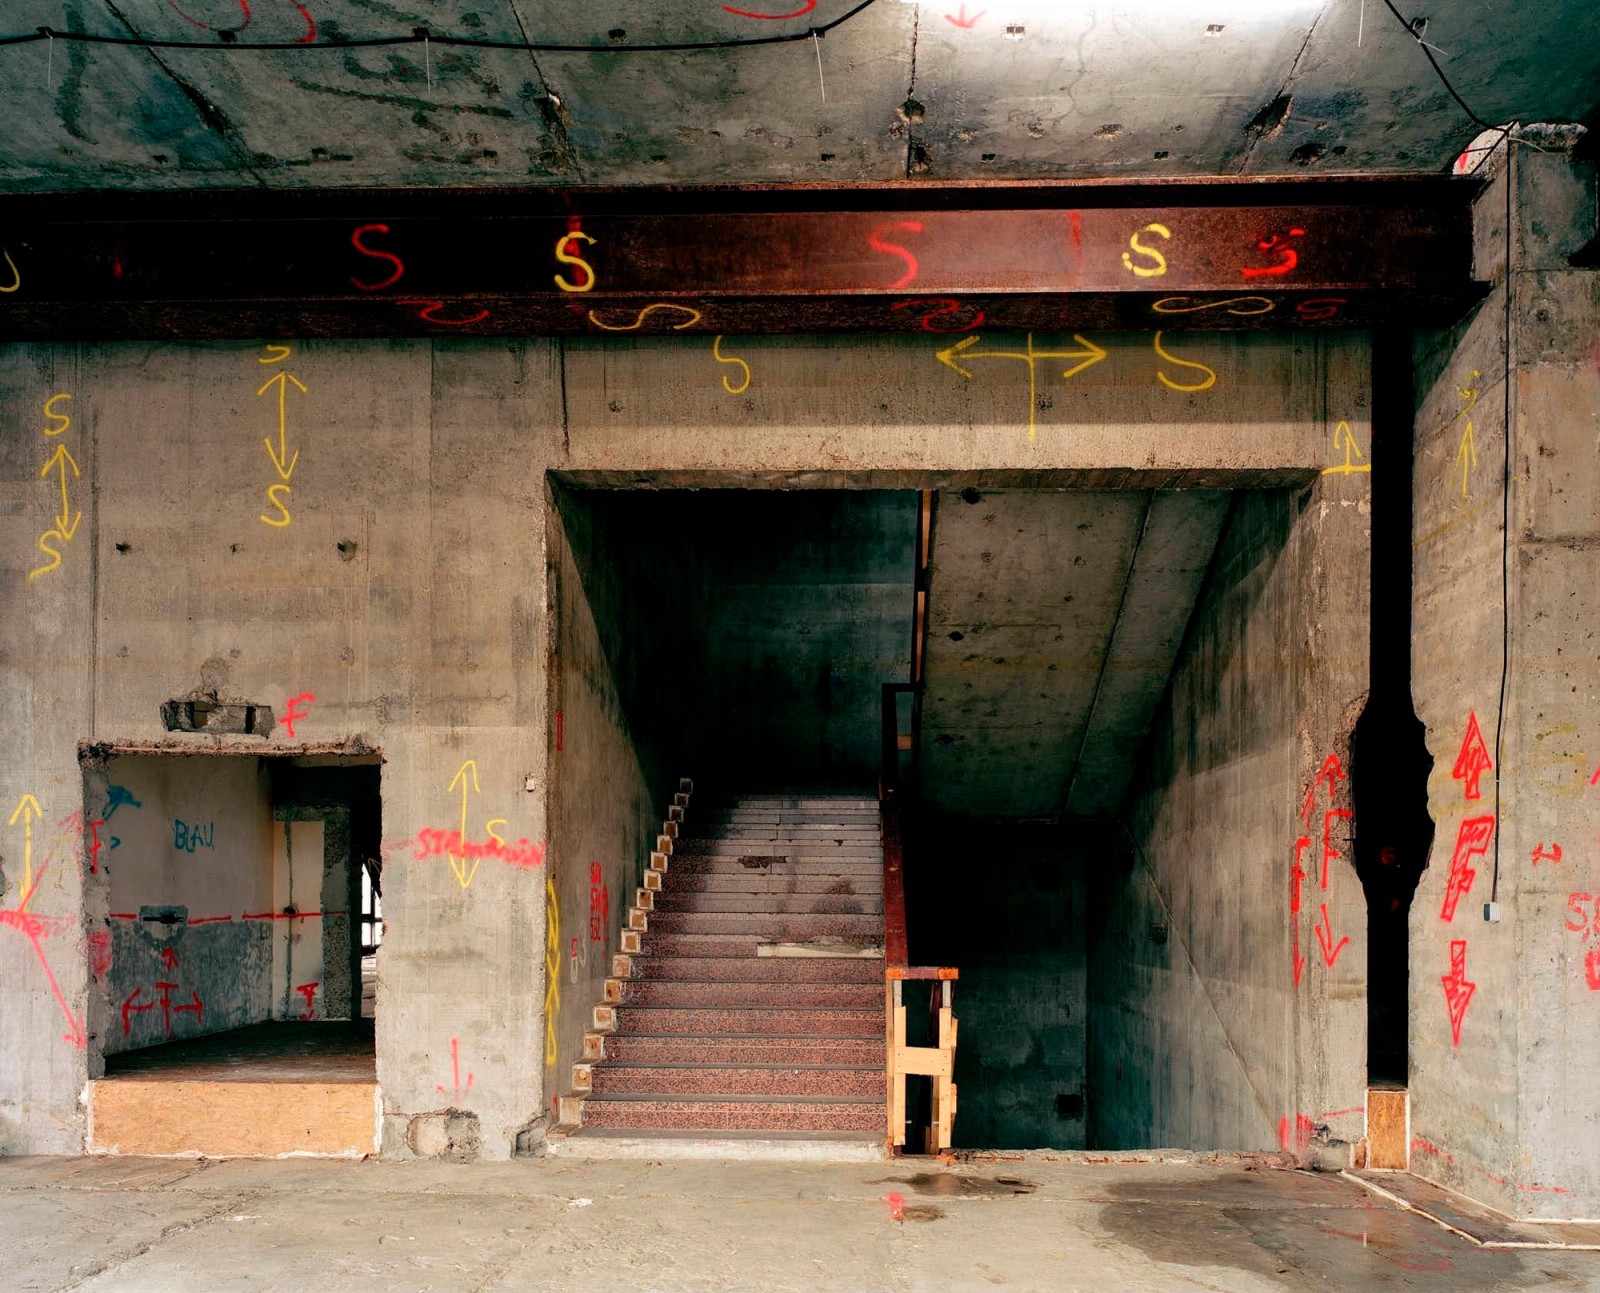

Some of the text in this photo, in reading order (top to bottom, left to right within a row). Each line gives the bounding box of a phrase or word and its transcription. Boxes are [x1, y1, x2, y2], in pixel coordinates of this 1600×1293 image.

[352, 224, 404, 290] S
[554, 231, 596, 293] S
[868, 221, 924, 288] S
[1121, 222, 1172, 278] S
[42, 393, 71, 437] S
[259, 483, 292, 528] S
[28, 530, 64, 582] S
[278, 692, 316, 739] F
[174, 818, 215, 854] BLAU
[1319, 807, 1354, 891] F
[1439, 815, 1495, 923] F
